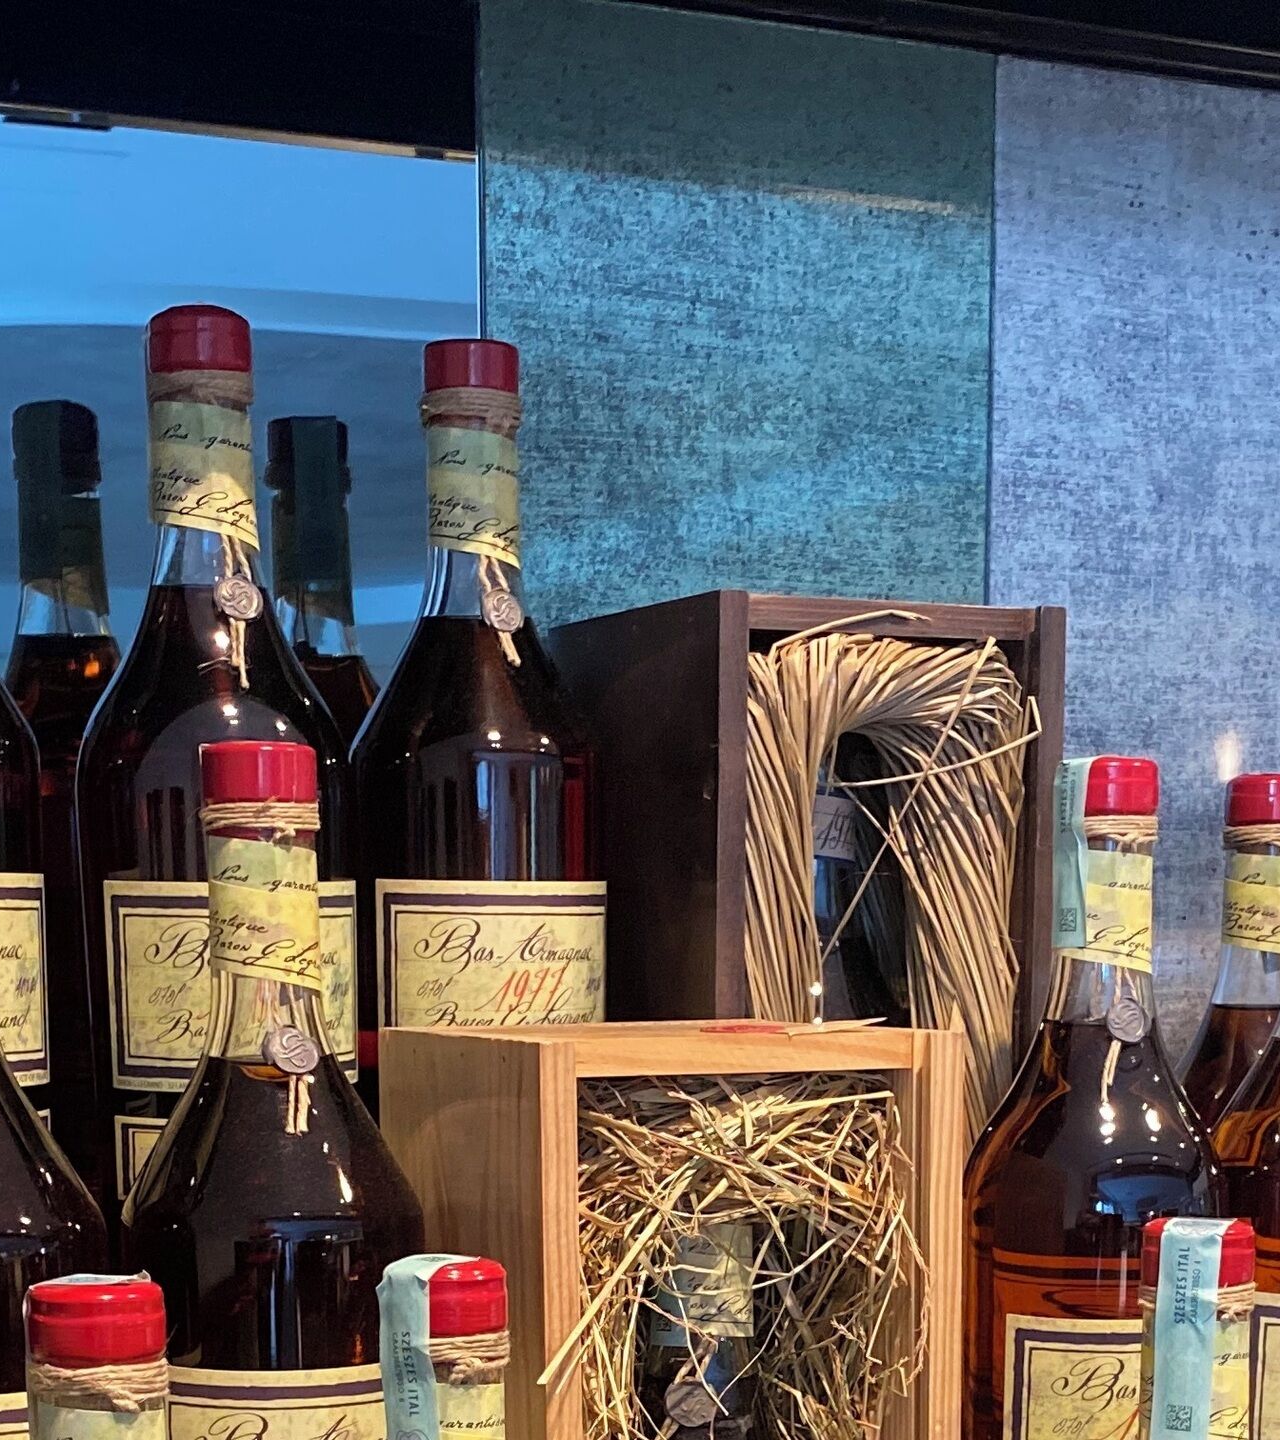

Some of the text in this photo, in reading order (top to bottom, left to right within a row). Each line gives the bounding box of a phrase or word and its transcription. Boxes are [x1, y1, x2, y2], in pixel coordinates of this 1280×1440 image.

[484, 966, 570, 1014] 1977
[1174, 1247, 1191, 1324] SZESZES ITAL
[402, 1331, 420, 1418] SZESZES ITAL
